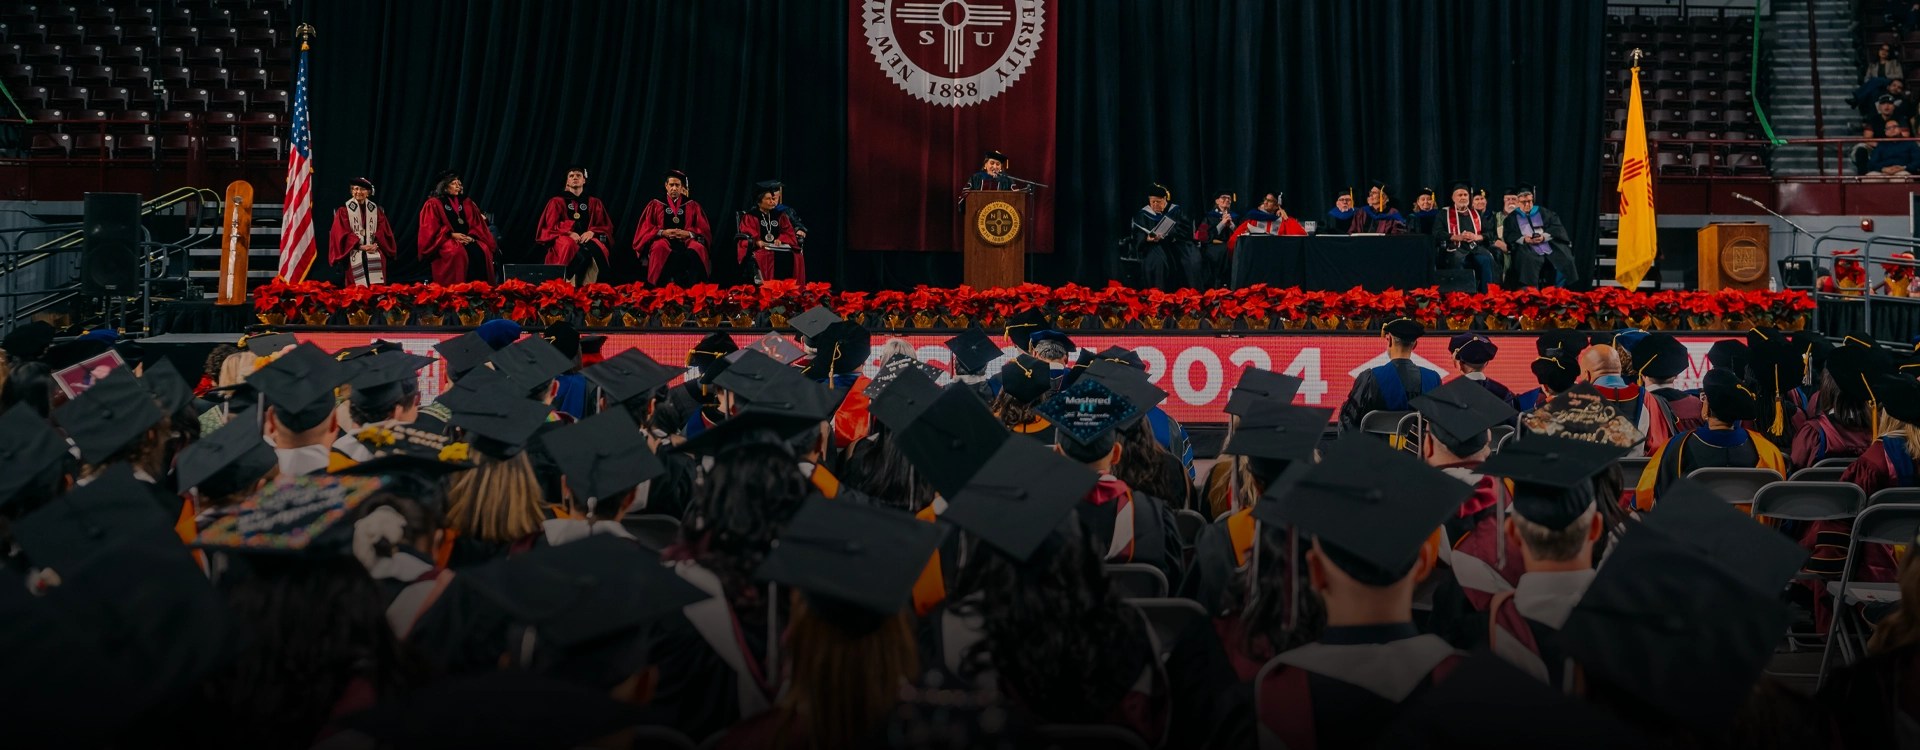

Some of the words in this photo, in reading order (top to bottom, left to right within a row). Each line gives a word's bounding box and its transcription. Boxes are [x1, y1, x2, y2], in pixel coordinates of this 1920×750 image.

[875, 36, 914, 82] NEW
[995, 0, 1036, 83] ERSITY
[919, 30, 935, 45] S
[973, 32, 995, 47] U
[927, 81, 978, 98] 1888
[1065, 396, 1112, 405] Mastered
